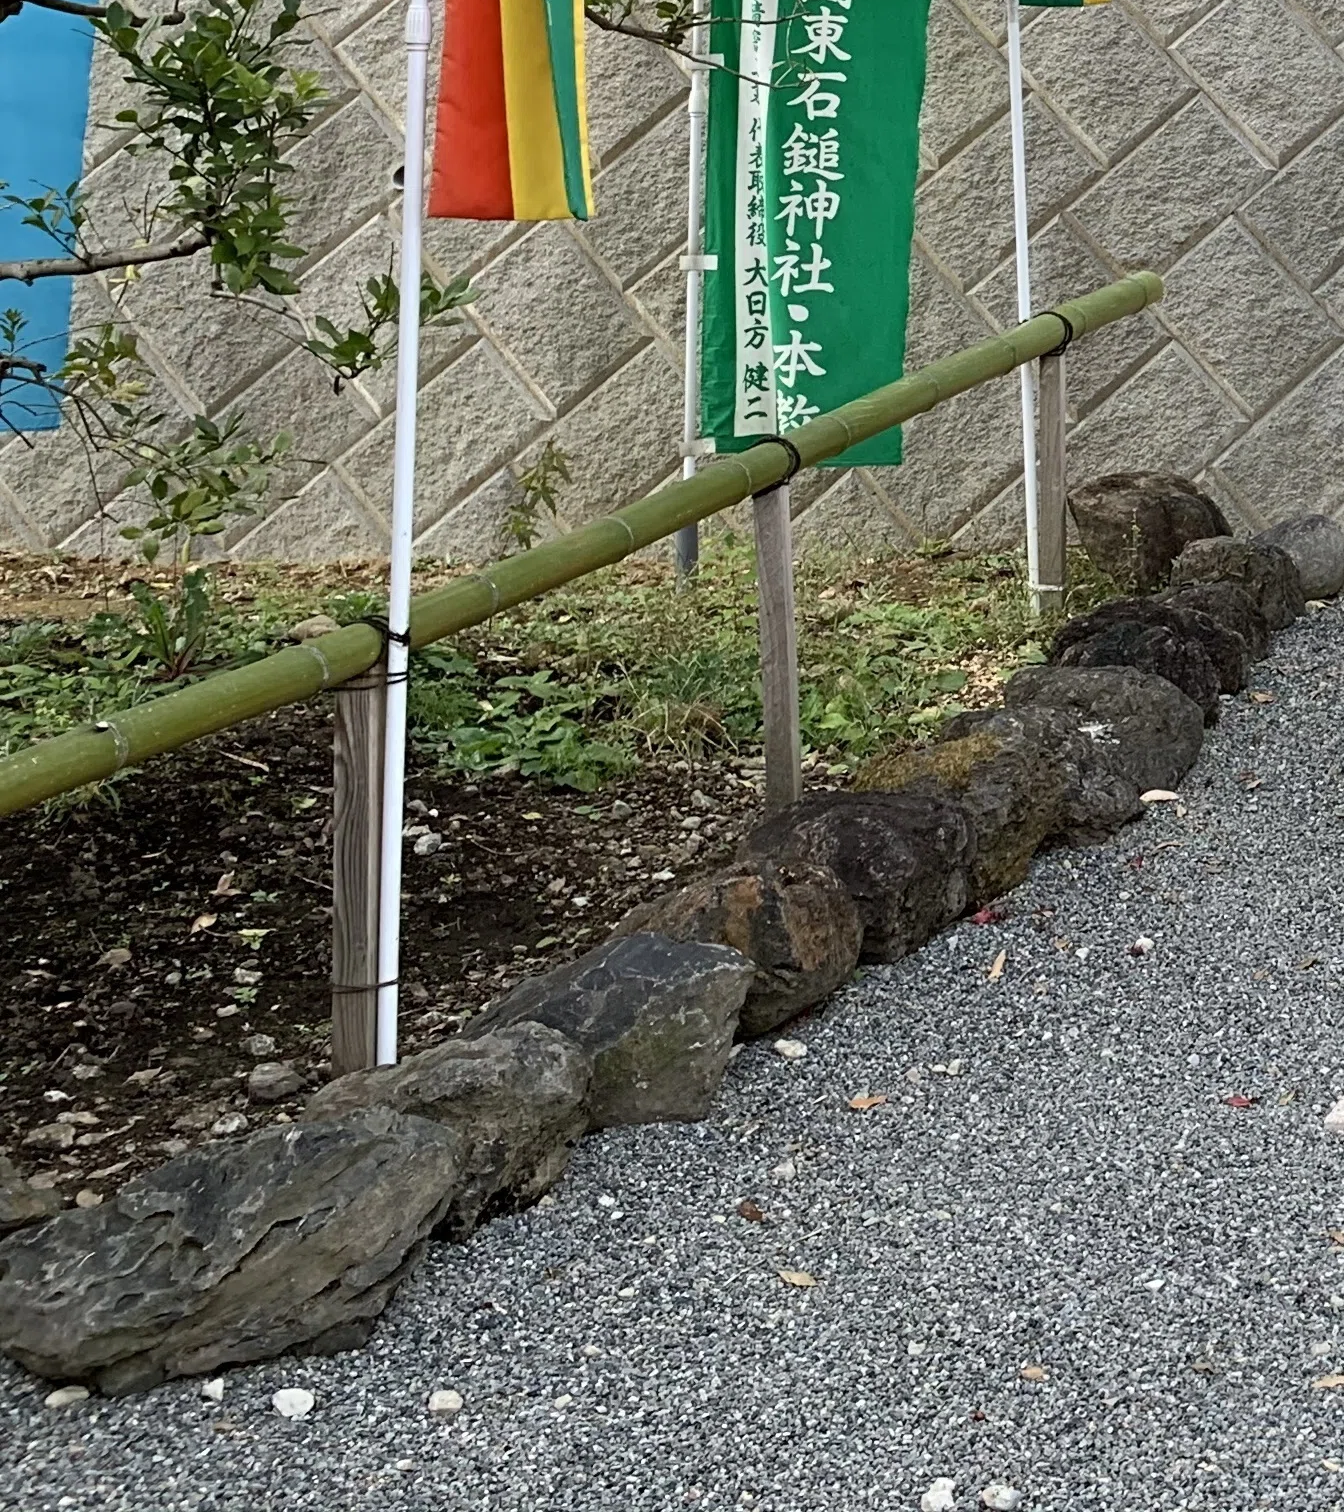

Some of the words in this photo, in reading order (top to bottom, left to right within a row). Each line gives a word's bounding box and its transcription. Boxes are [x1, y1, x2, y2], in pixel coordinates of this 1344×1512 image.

[743, 257, 769, 350] 大日方
[742, 361, 770, 421] 健二
